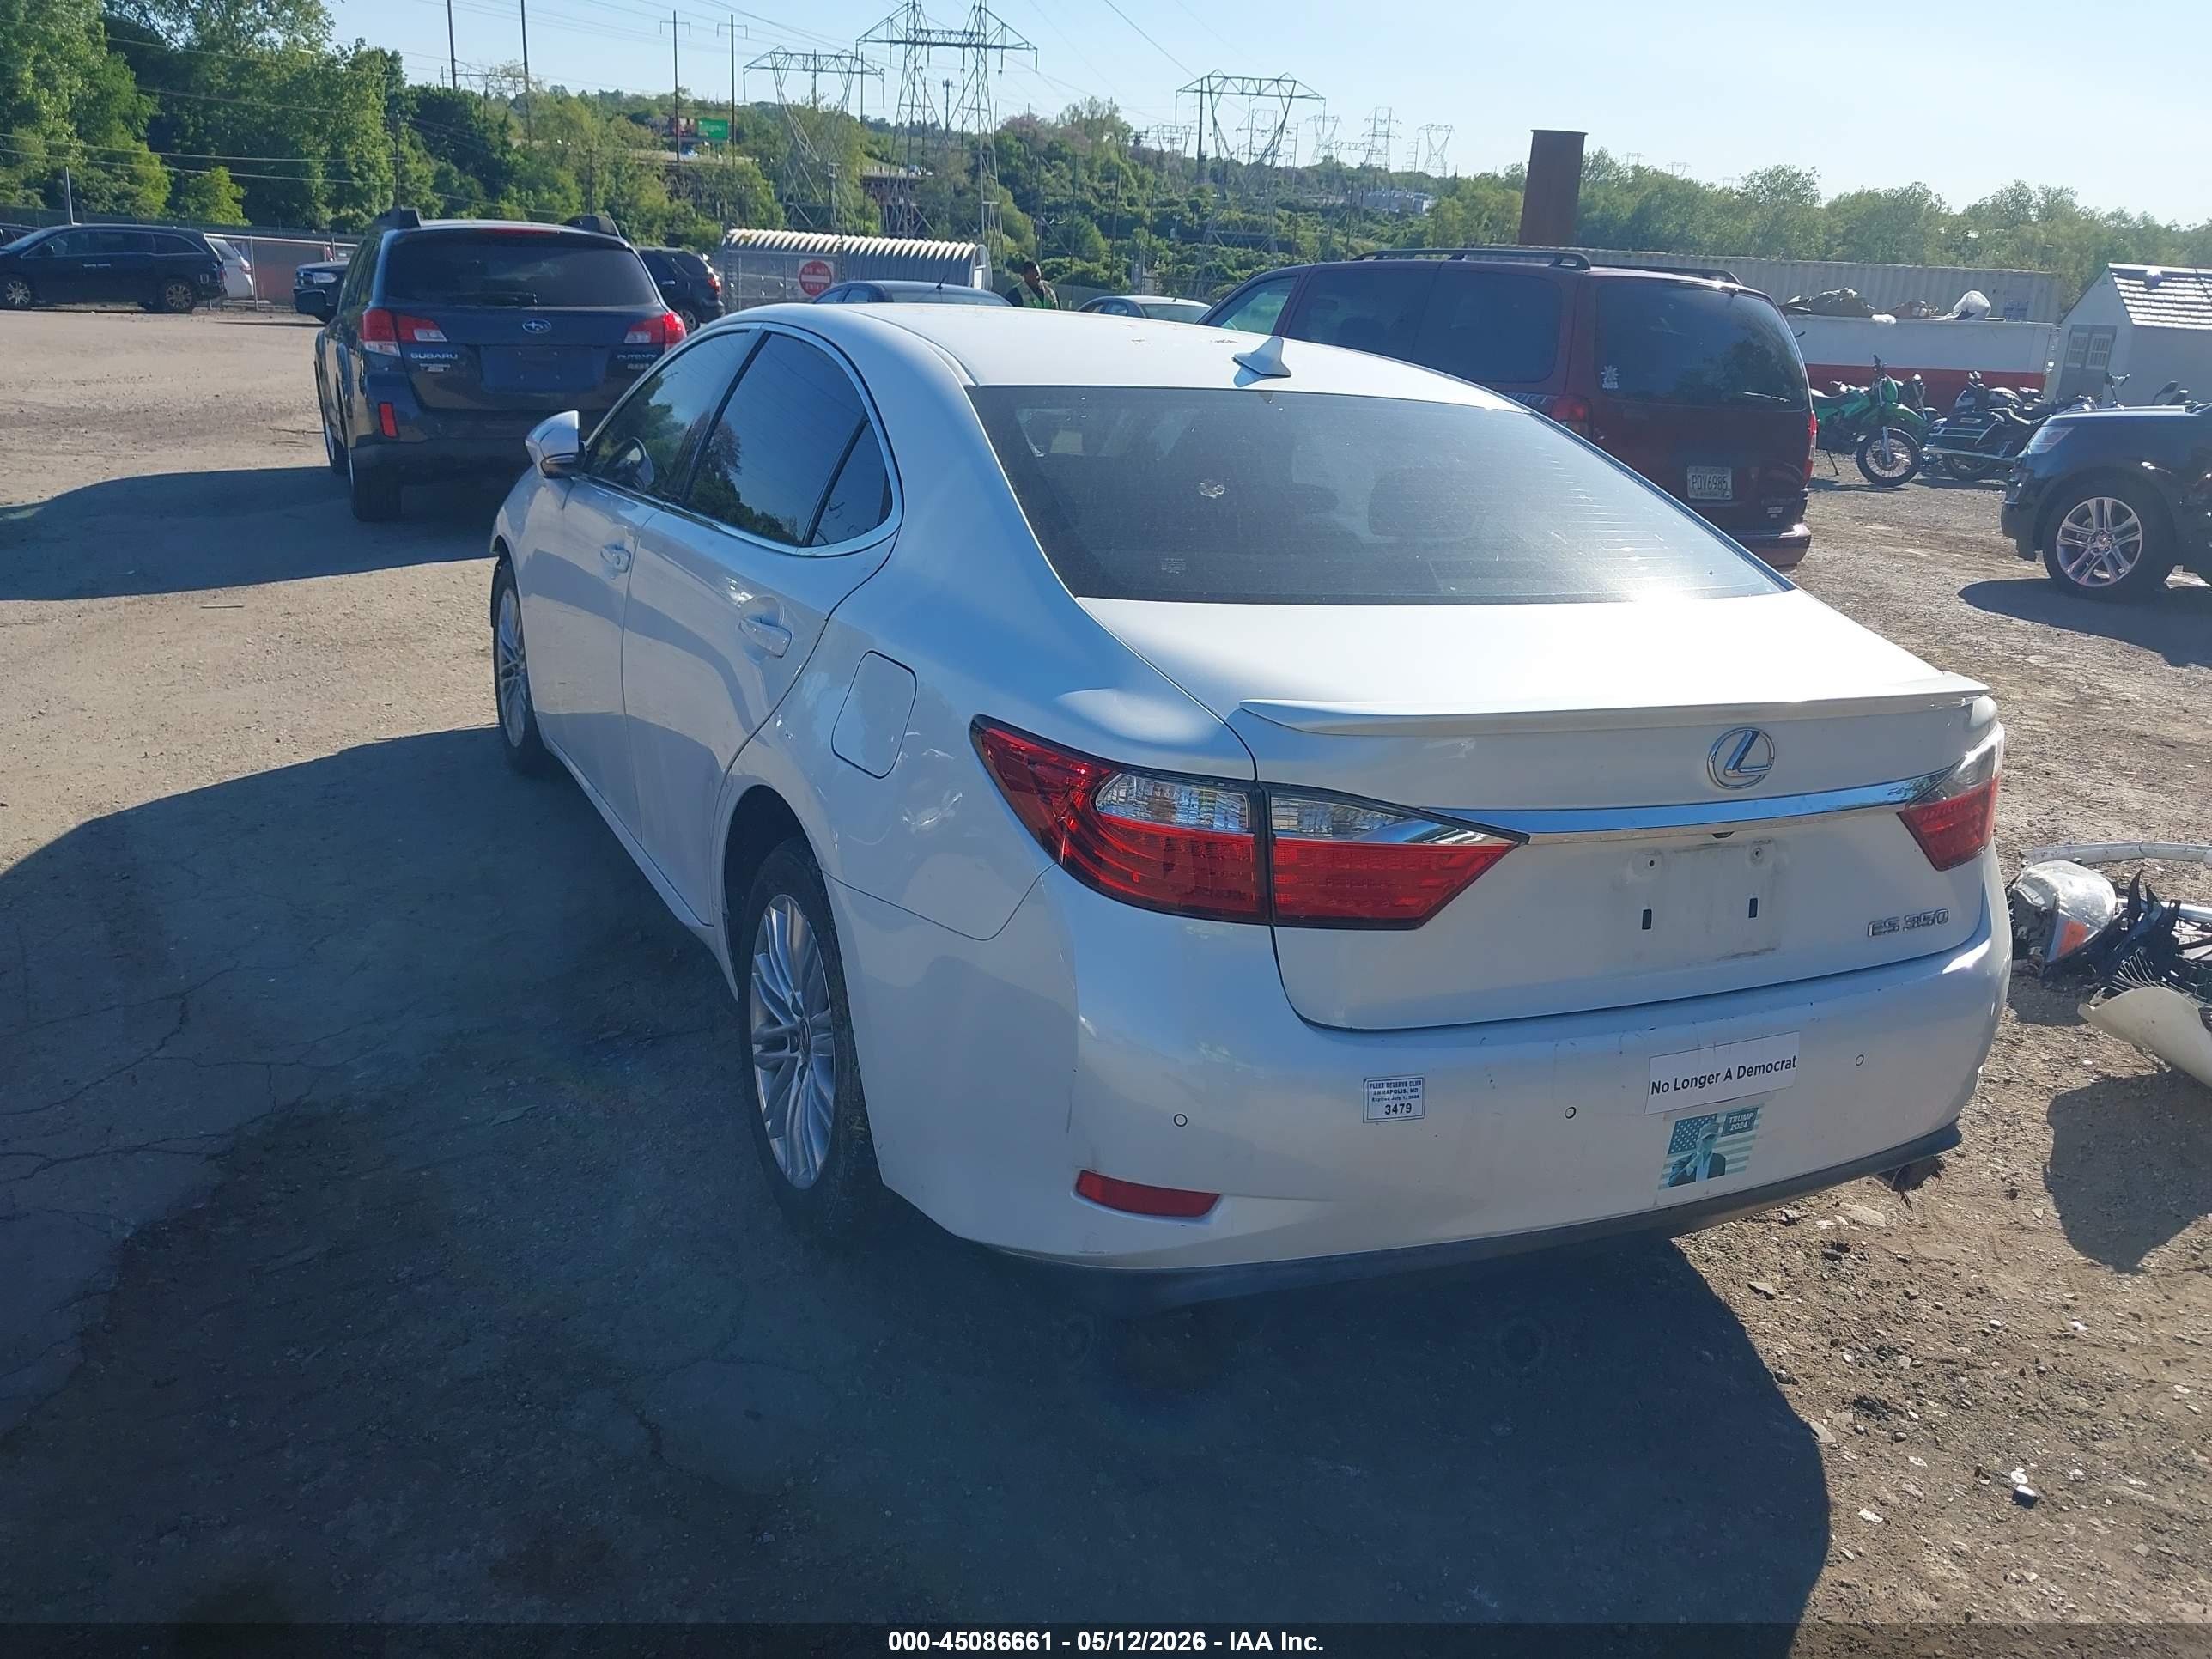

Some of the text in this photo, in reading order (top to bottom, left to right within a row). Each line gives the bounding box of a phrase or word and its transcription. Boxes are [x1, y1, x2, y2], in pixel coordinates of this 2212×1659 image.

[1867, 908, 1949, 937] ES 350
[1650, 1055, 1797, 1095] No Longer A Democrat
[1384, 1103, 1413, 1115] 3479
[1729, 1112, 1754, 1124] TRUMP
